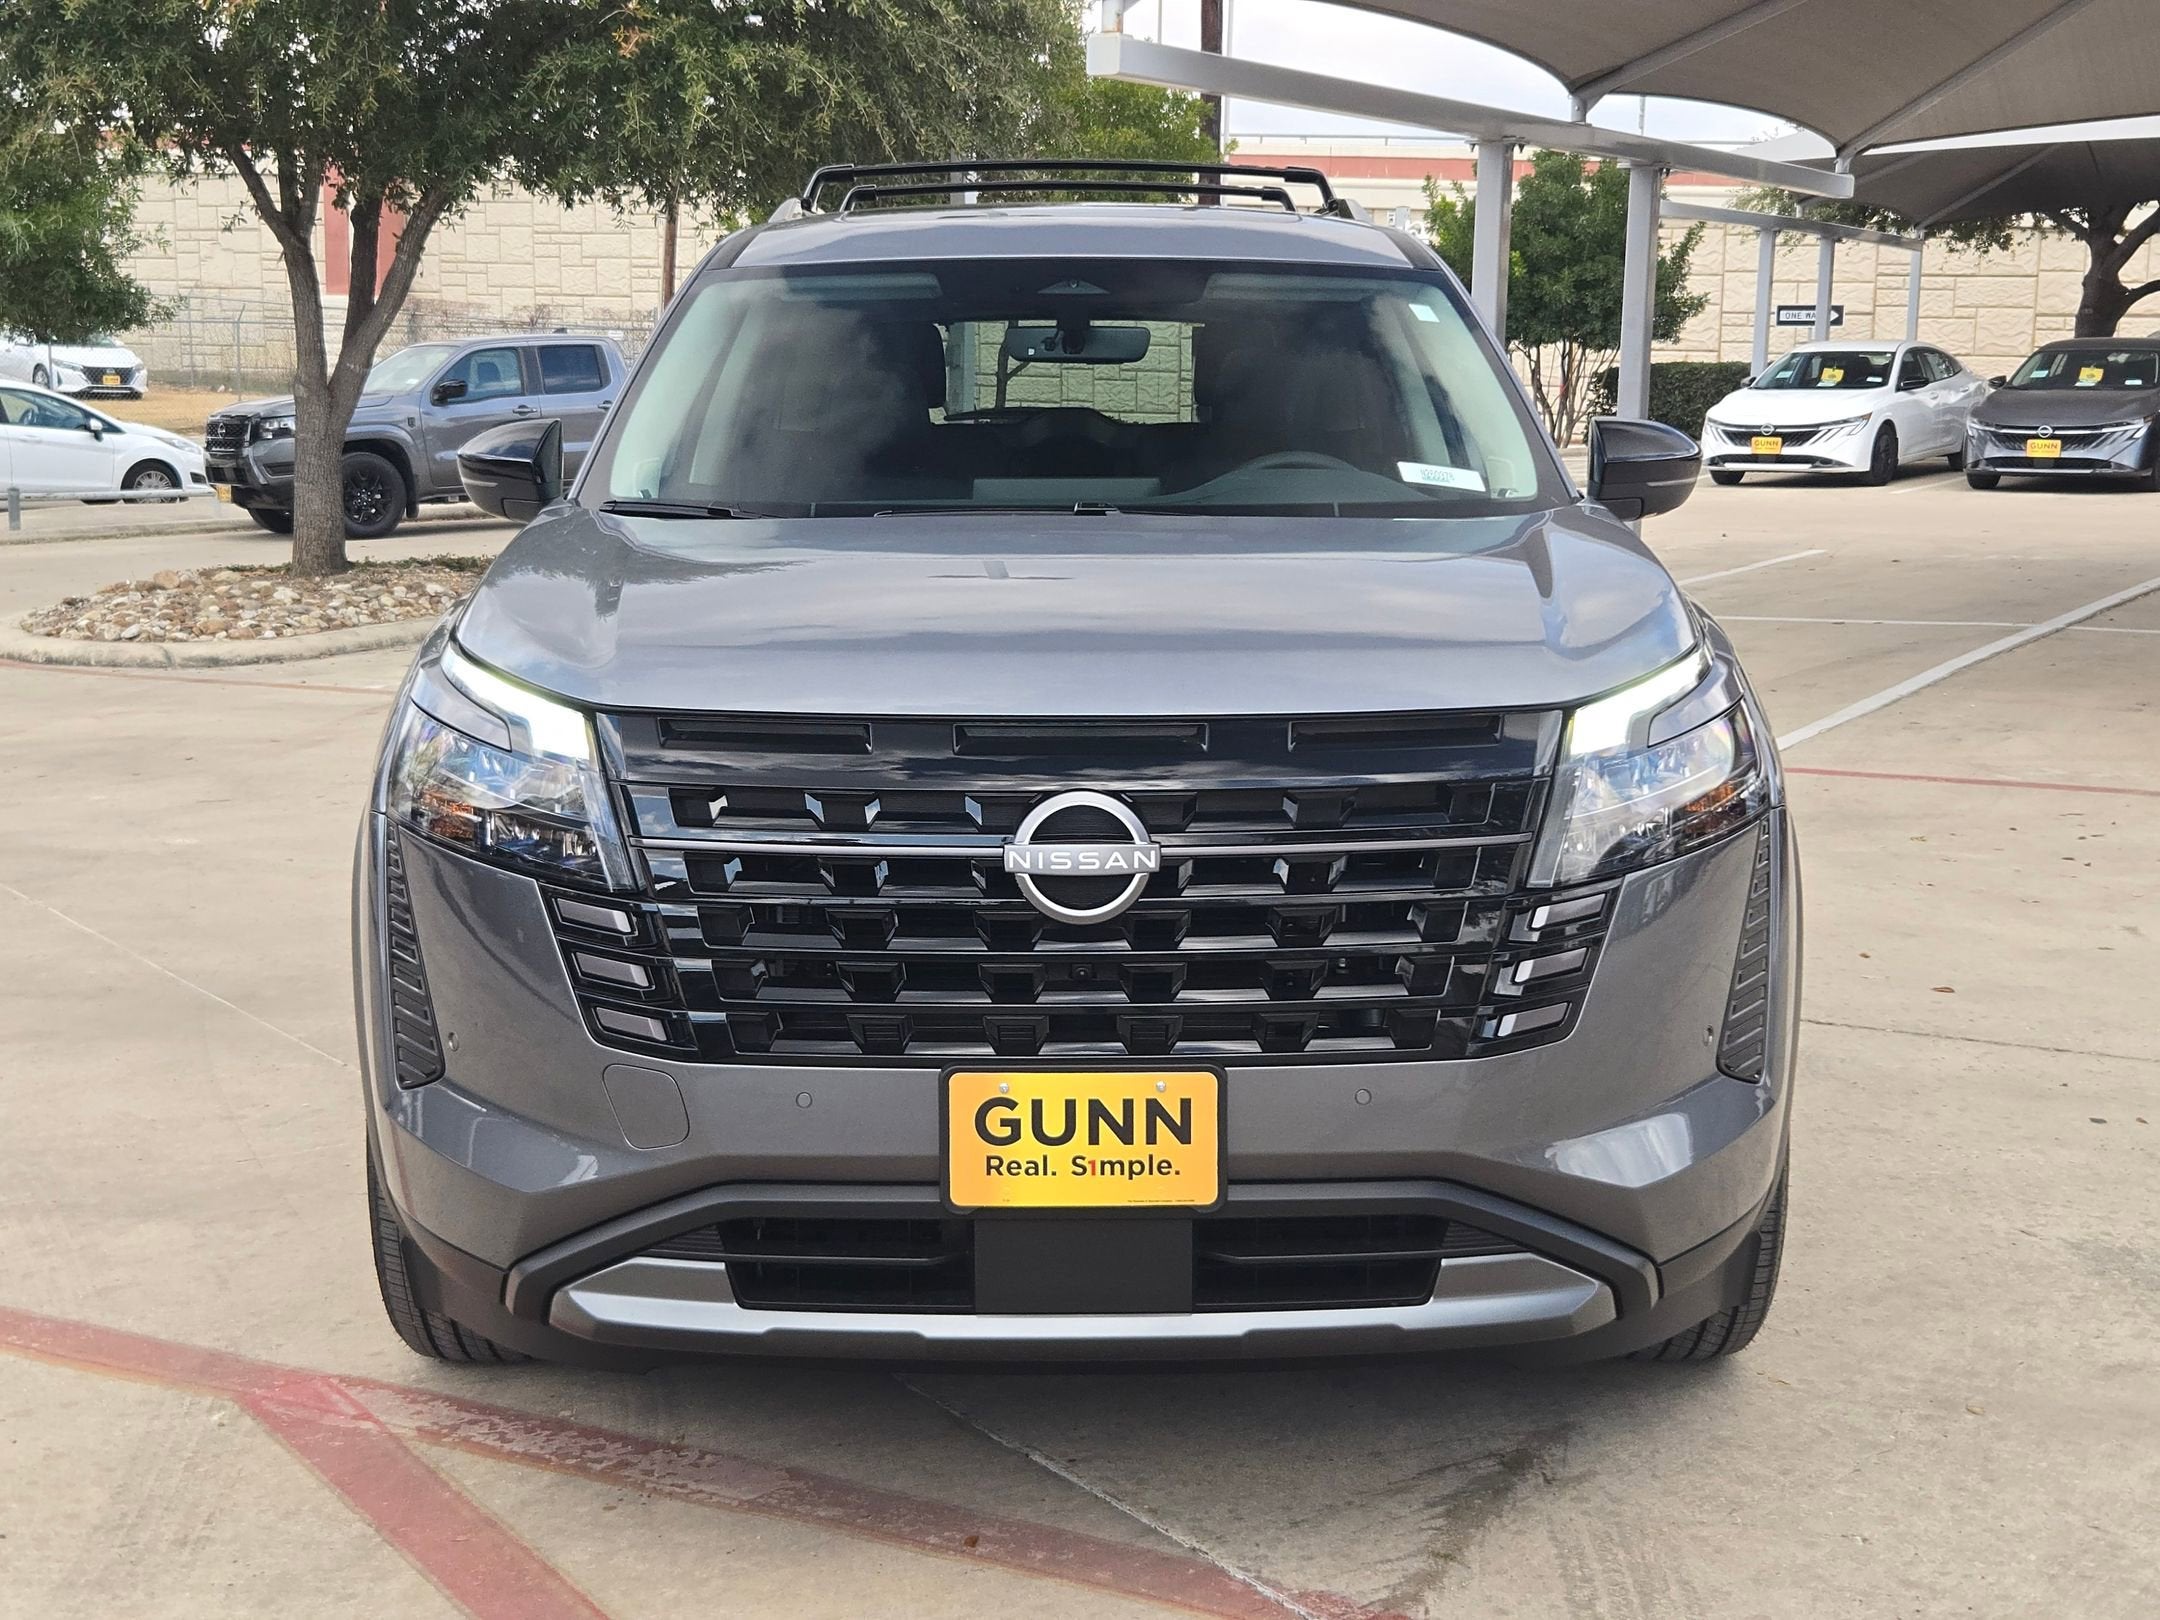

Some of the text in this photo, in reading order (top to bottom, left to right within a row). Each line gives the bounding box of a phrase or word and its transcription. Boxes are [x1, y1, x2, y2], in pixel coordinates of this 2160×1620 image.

[1754, 439, 1779, 447] GUNN
[2030, 442, 2059, 450] GUNN
[1008, 850, 1156, 870] NISSAN
[974, 1096, 1192, 1147] GUNN
[985, 1154, 1058, 1177] Real.
